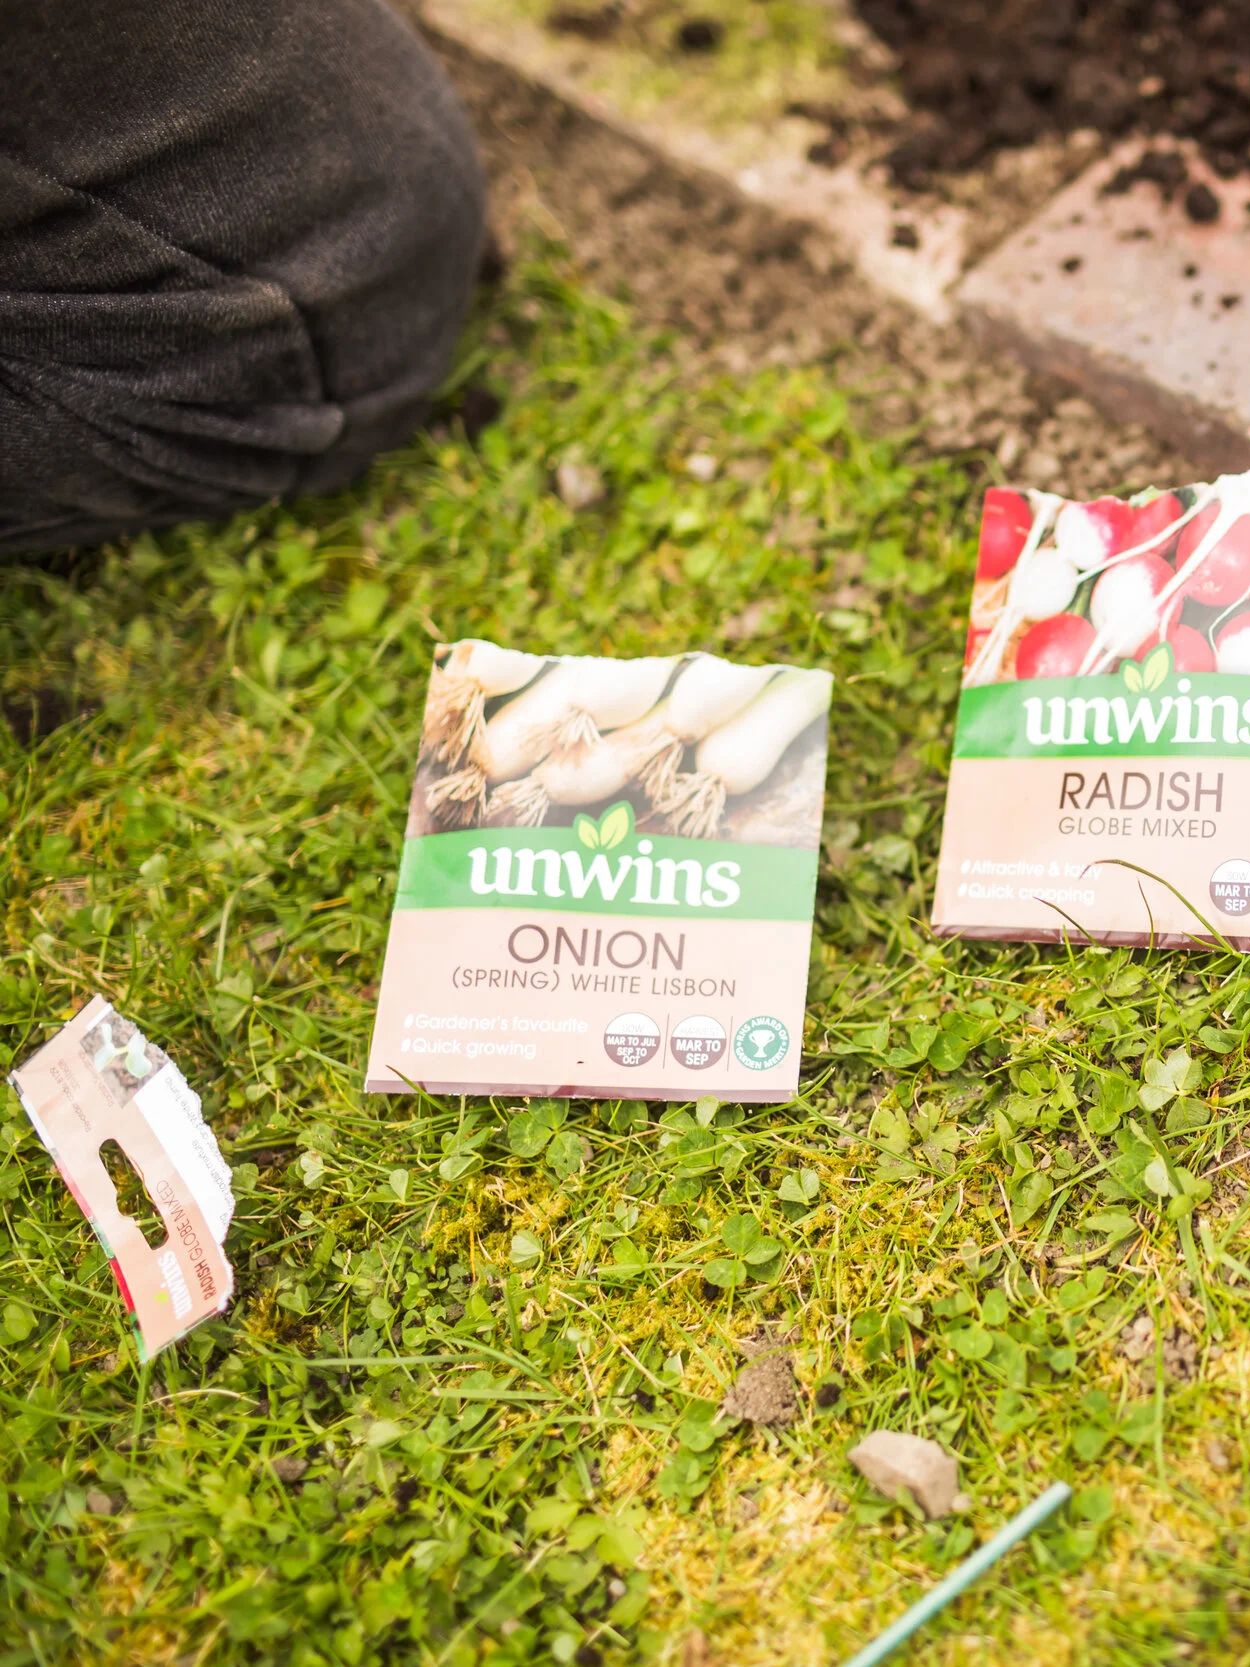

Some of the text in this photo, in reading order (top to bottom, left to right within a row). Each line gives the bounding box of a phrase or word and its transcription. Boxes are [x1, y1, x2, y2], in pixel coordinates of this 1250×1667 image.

[1059, 771, 1224, 812] RADISH
[1058, 816, 1217, 839] GLOBE MIXED
[468, 839, 742, 908] unwins
[971, 859, 1045, 876] Attractive
[1047, 861, 1061, 877] &
[968, 882, 1096, 906] Quick cropping
[1215, 884, 1240, 897] MAR
[1225, 899, 1248, 911] SEP
[508, 923, 686, 971] ONION
[452, 966, 736, 997] (SPRING) WHITE LISBON
[415, 1013, 589, 1033] Gardener's favourite
[736, 1017, 788, 1041] RHS AWARD OF
[412, 1038, 537, 1060] Quick growing
[606, 1036, 656, 1047] MAR TO JUL
[617, 1047, 647, 1057] SEP TO
[676, 1040, 721, 1052] MAR TO
[623, 1056, 640, 1065] OCT
[685, 1053, 709, 1066] SEP
[735, 1046, 786, 1069] GARDEN MERIT
[156, 1180, 217, 1301] RADISH GLOBE MIXED
[157, 1250, 193, 1320] unwins
